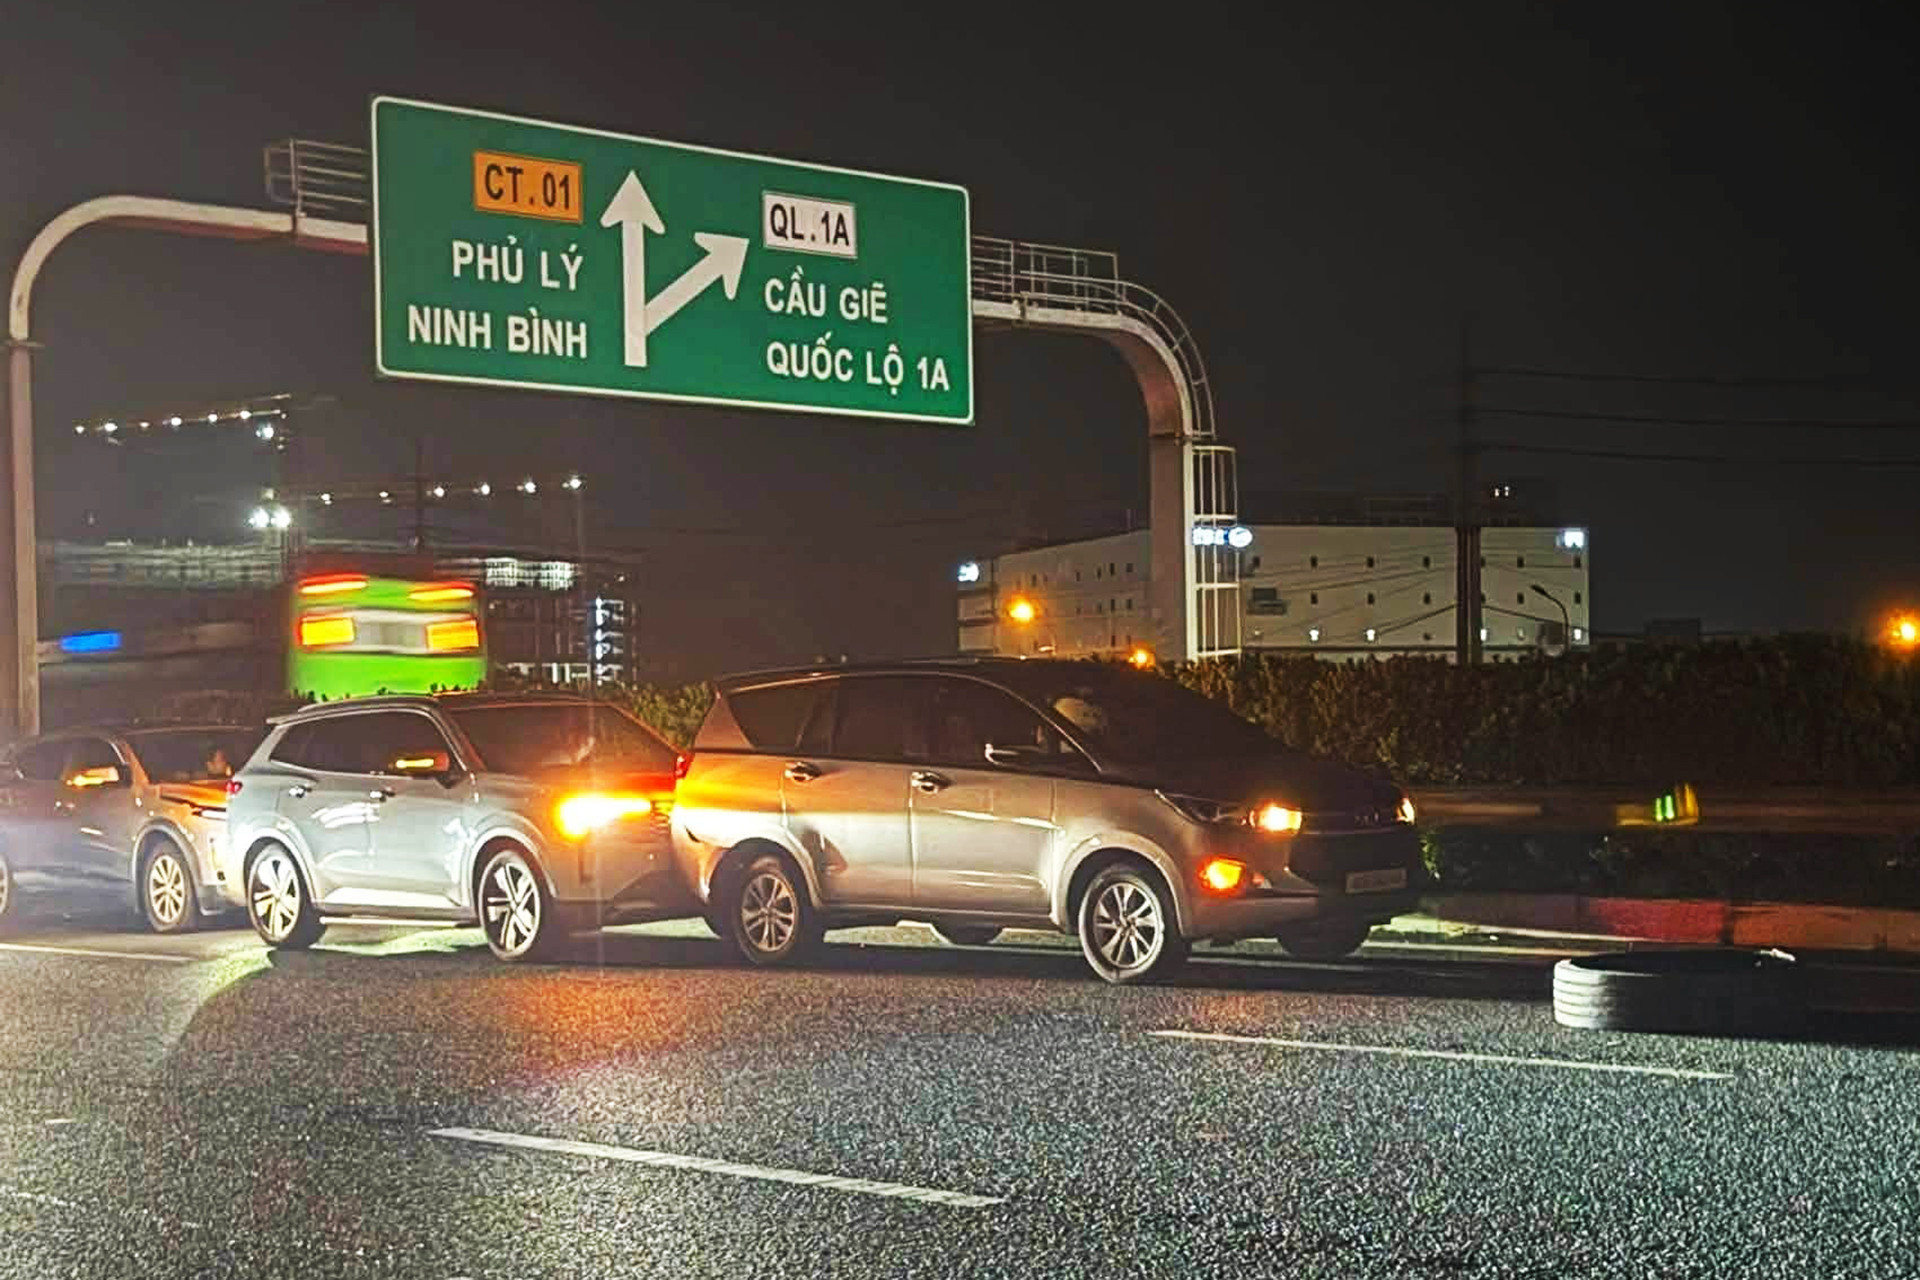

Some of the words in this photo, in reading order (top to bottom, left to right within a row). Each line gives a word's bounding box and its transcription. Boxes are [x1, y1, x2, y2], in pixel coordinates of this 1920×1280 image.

[484, 163, 571, 210] CT.01
[770, 203, 850, 246] QL.1A
[452, 235, 523, 284] PHỦ
[541, 244, 583, 291] LÝ
[765, 265, 826, 316] CẦU
[839, 282, 888, 323] GIẼ
[408, 305, 492, 350] NINH
[507, 308, 588, 358] BÌNH
[766, 331, 854, 382] QUỐC
[866, 343, 903, 395] LỘ
[916, 357, 950, 391] 1A
